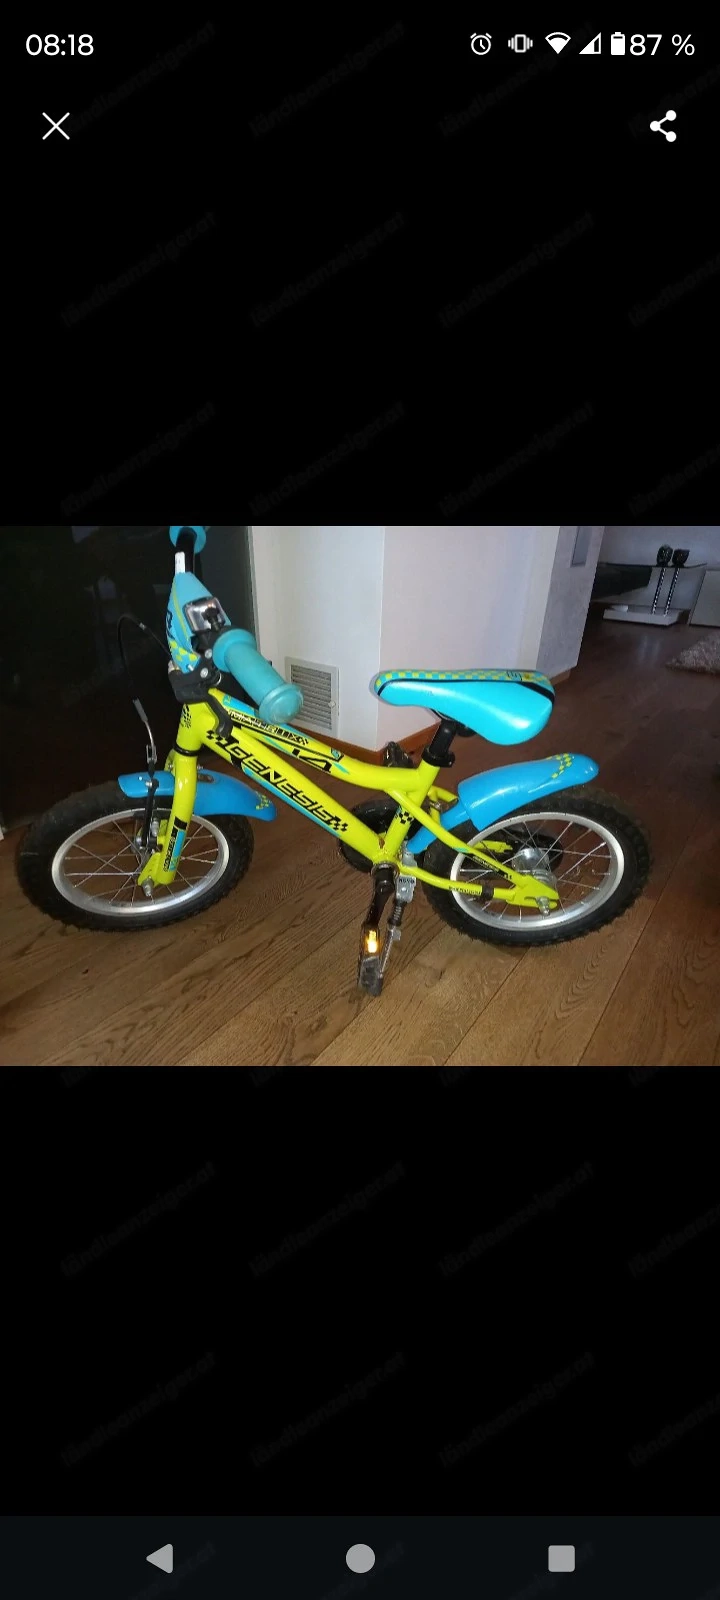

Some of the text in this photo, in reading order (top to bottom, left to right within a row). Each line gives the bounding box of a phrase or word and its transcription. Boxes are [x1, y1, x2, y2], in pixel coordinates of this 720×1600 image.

[25, 34, 94, 56] 08:18
[629, 33, 695, 56] 87 %
[226, 741, 336, 825] GENESIS
